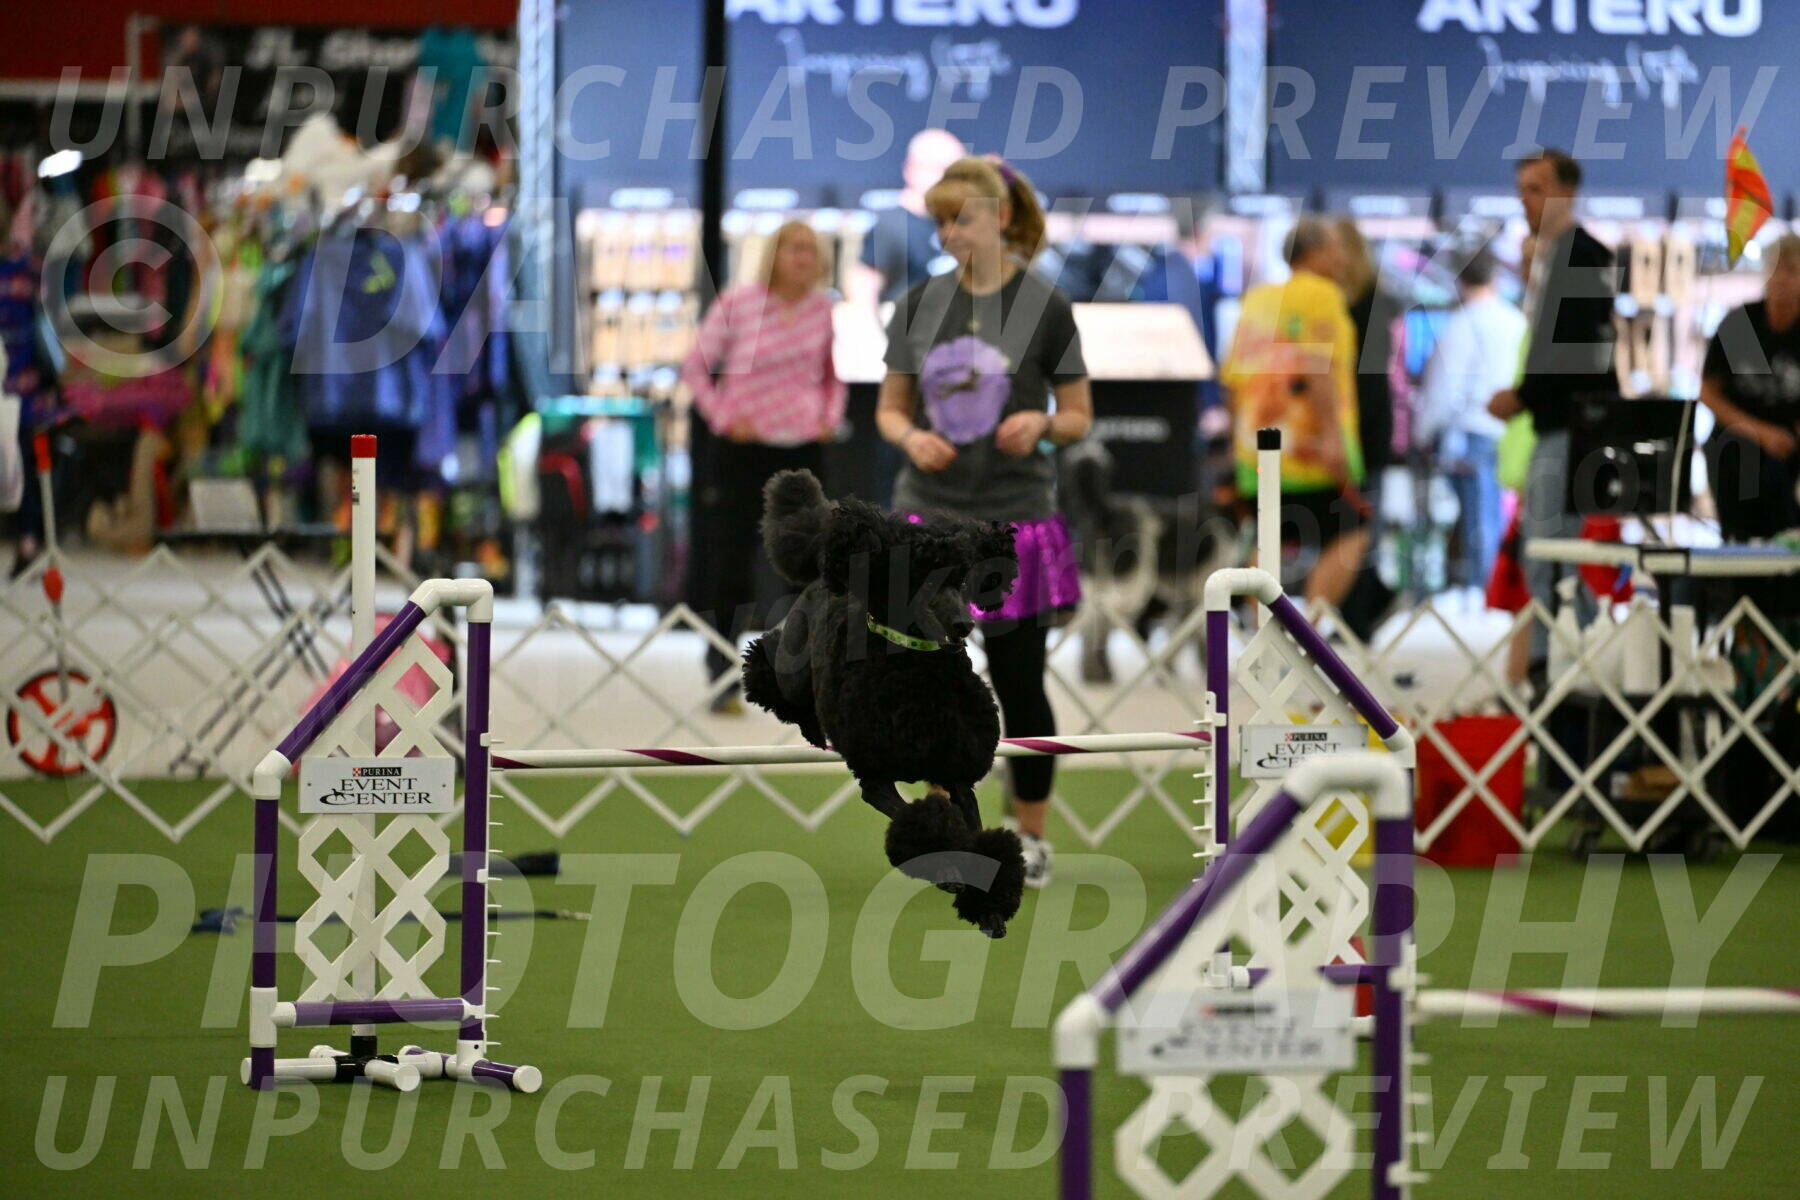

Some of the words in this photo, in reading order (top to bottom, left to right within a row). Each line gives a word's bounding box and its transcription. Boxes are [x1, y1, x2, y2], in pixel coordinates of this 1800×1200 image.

[1275, 743, 1341, 756] EVENT
[362, 767, 401, 777] PURINA
[341, 778, 417, 791] EVENT
[320, 790, 432, 805] CENTER
